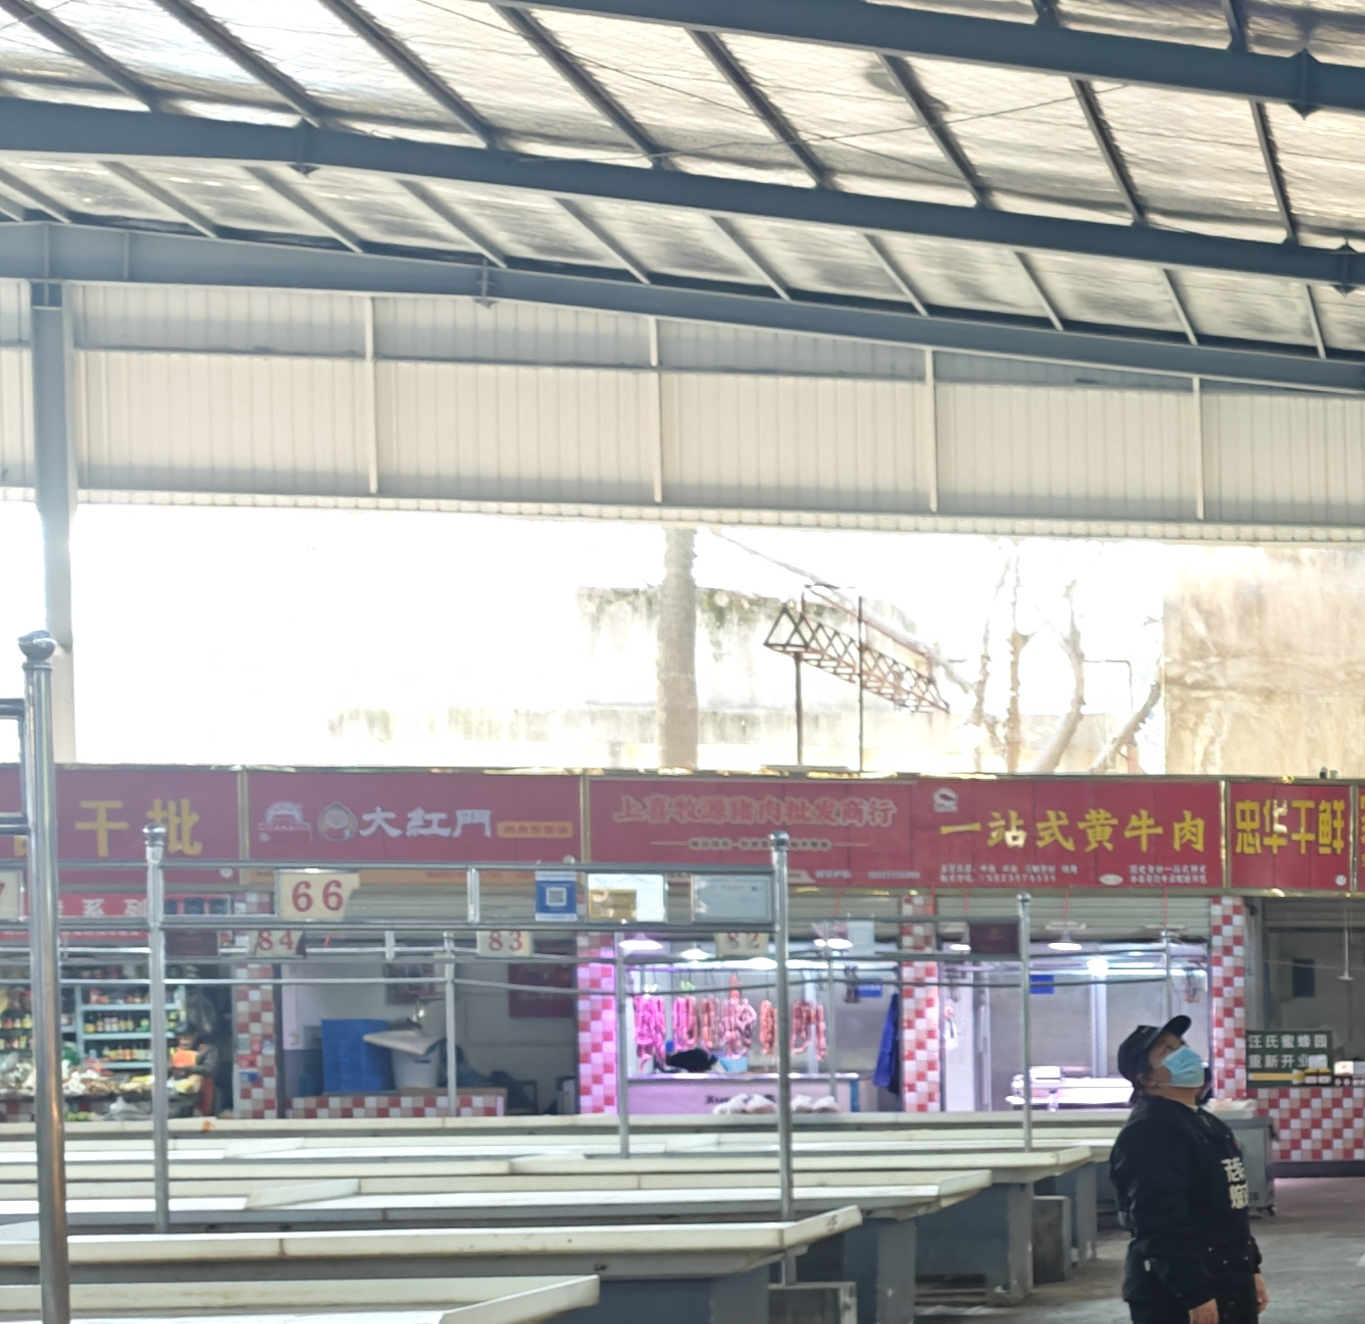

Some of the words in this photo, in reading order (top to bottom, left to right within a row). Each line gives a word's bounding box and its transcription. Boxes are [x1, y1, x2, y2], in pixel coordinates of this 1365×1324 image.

[939, 808, 1206, 852] 一站式黄牛肉
[1235, 799, 1345, 855] 忠华干鲜
[291, 880, 344, 912] 66
[257, 930, 294, 951] 84
[488, 929, 524, 951] 83
[1248, 1034, 1328, 1049] 汪氏蜜蜂园
